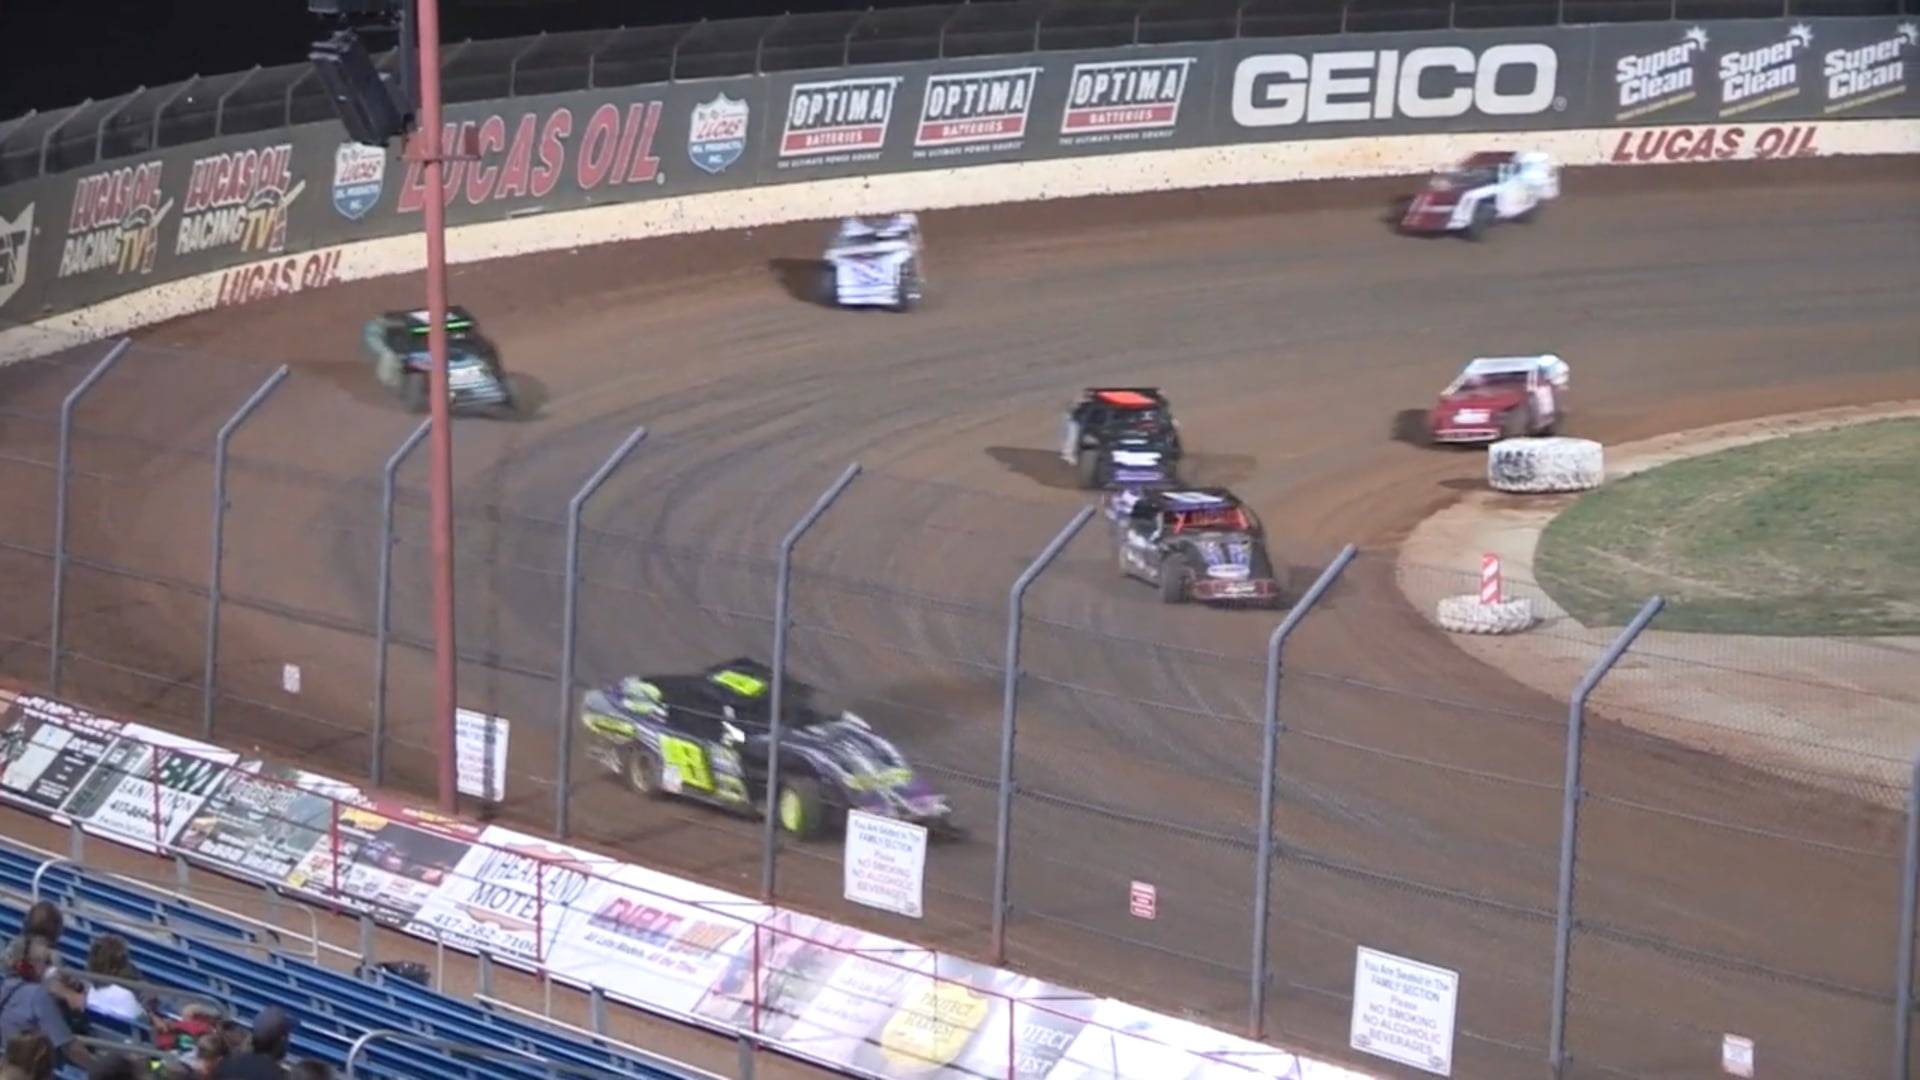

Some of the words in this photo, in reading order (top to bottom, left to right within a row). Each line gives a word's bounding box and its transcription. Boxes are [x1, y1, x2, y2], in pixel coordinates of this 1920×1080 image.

[1617, 41, 1697, 83] Super
[1720, 39, 1800, 80] Super
[1825, 37, 1906, 77] Super
[929, 78, 1024, 117] OPTIMA
[1075, 66, 1177, 106] OPTIMA
[1232, 43, 1558, 127] GEICO
[1620, 67, 1693, 106] Clean
[1722, 64, 1796, 102] Clean
[1828, 61, 1903, 99] Clean
[791, 89, 885, 127] OPTIMA
[1090, 110, 1153, 124] BATTERIES
[696, 119, 743, 139] LUCAS
[806, 130, 863, 146] BATTERIES
[942, 120, 1003, 137] BATTERIES
[1611, 128, 1744, 162] LUCAS
[1754, 127, 1818, 158] OIL
[340, 160, 381, 183] LUCAS
[397, 108, 573, 213] LUCAS
[577, 100, 663, 189] OIL
[70, 166, 132, 233] LUCAS
[124, 161, 163, 222] OIL
[183, 149, 257, 213] LUCAS
[248, 144, 293, 196] OIL
[175, 208, 245, 255] RACING
[240, 205, 279, 252] TV
[58, 226, 122, 278] RACING
[117, 228, 148, 274] TV
[216, 258, 297, 306] LUCAS
[302, 250, 344, 287] OIL
[1372, 974, 1399, 991] FAMILY
[1403, 984, 1439, 1002] SECTION
[1381, 964, 1394, 976] Are
[1369, 1003, 1385, 1014] NO
[1388, 1007, 1437, 1029] SMOKING
[1390, 995, 1418, 1010] Please
[1363, 1013, 1378, 1026] NO
[1381, 1019, 1440, 1044] ALCOHOLIC
[1369, 1028, 1433, 1055] BEVERAGES
